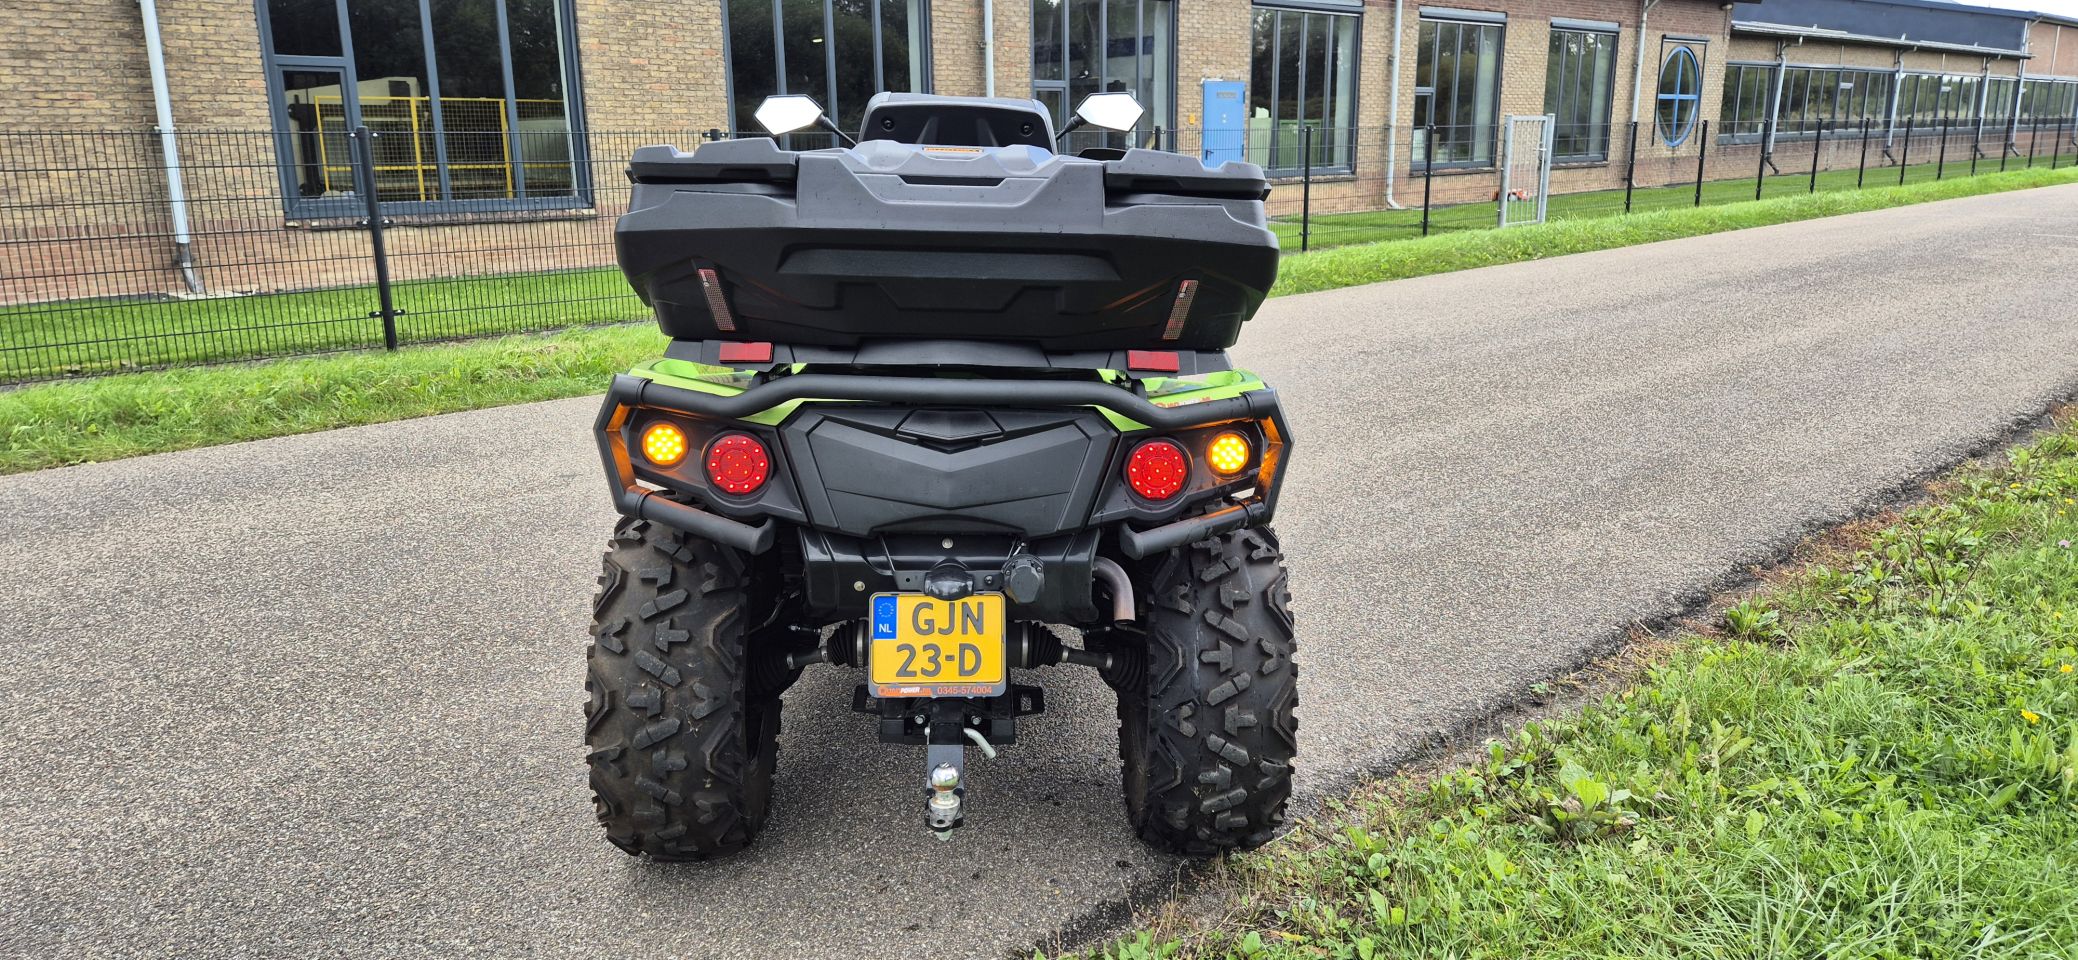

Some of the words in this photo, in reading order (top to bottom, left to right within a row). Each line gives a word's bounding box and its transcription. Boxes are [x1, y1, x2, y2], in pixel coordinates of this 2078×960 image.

[879, 624, 892, 633] NL
[912, 602, 984, 635] GJN
[896, 643, 982, 677] 23-D
[937, 686, 993, 695] 0345-574004
